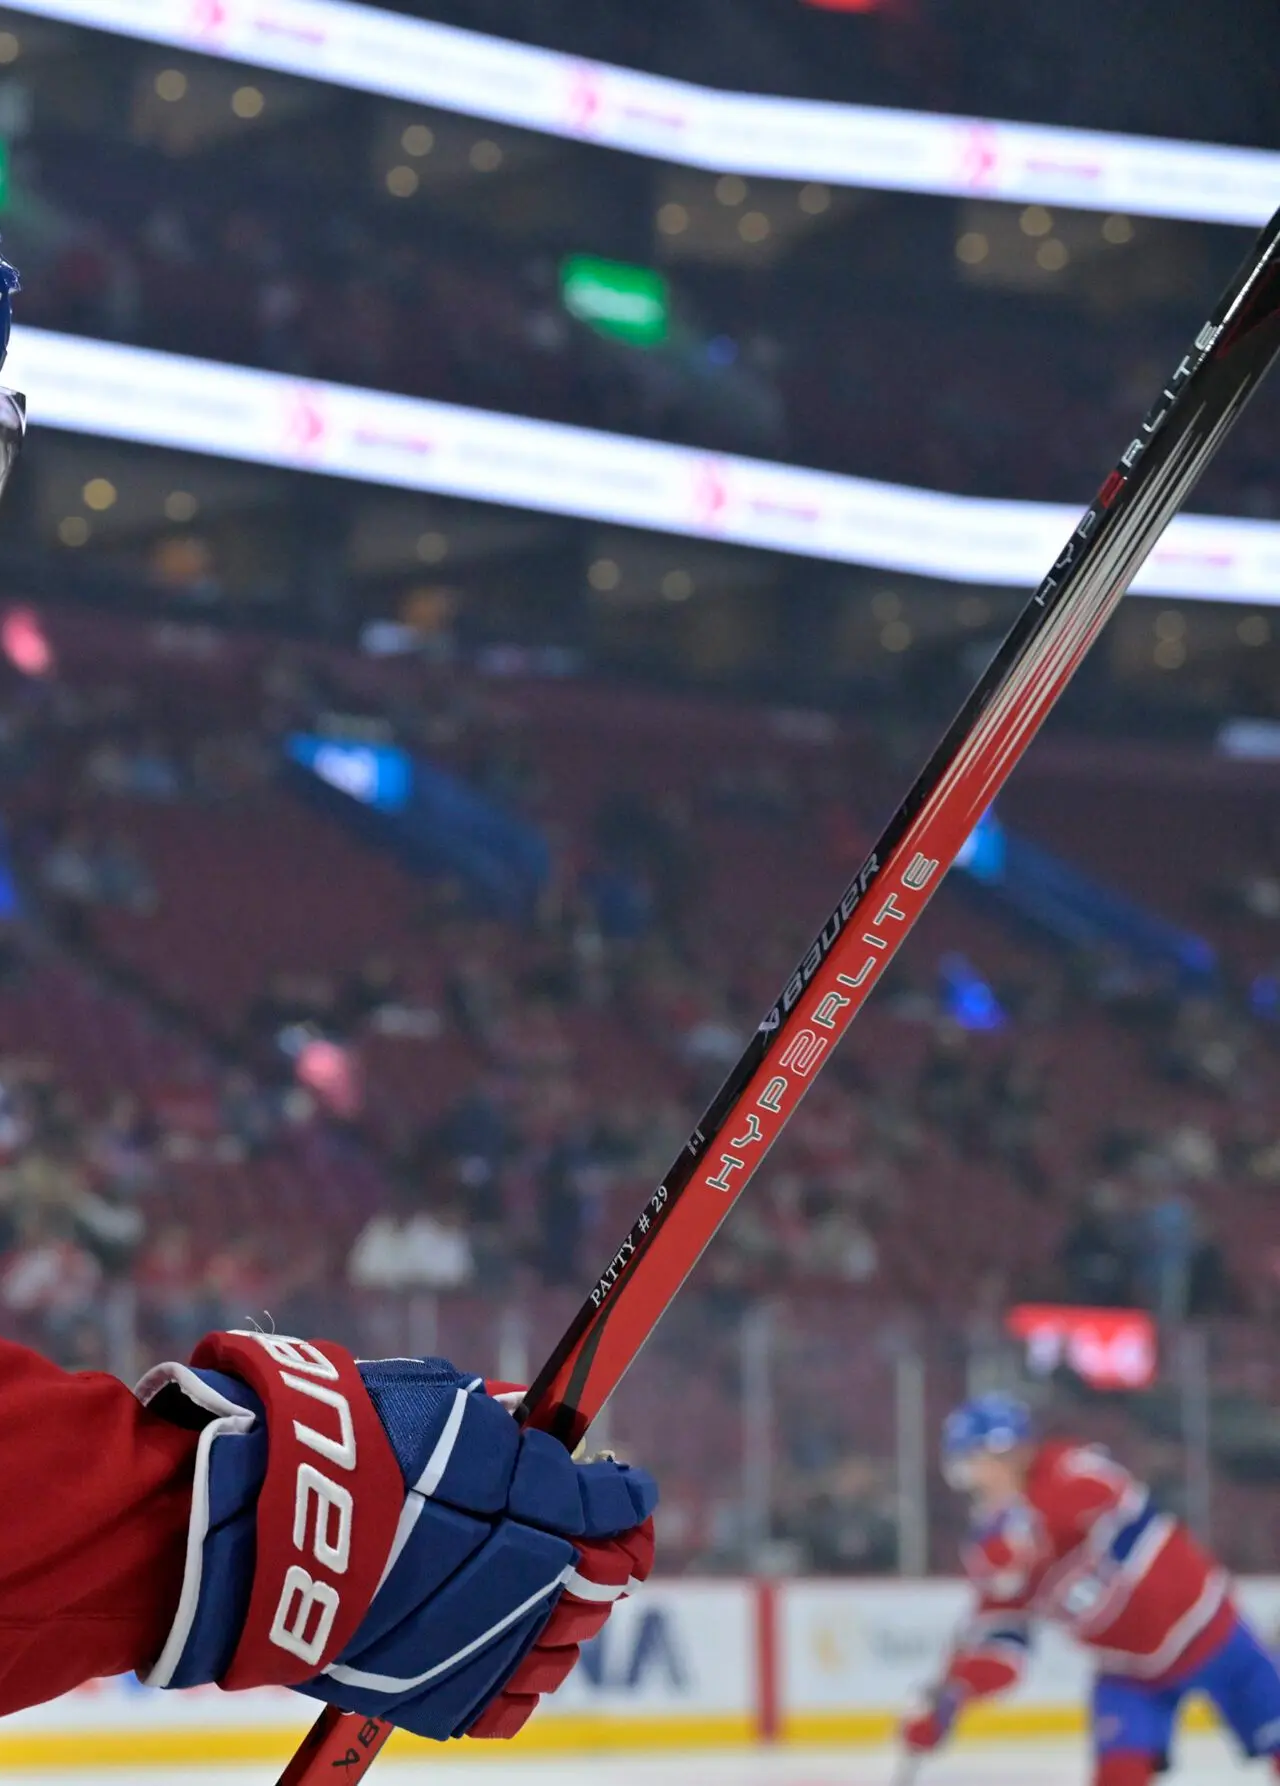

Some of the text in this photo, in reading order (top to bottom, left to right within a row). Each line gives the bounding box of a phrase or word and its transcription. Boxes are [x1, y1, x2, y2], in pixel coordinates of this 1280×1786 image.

[589, 1185, 669, 1308] PATTY # 29
